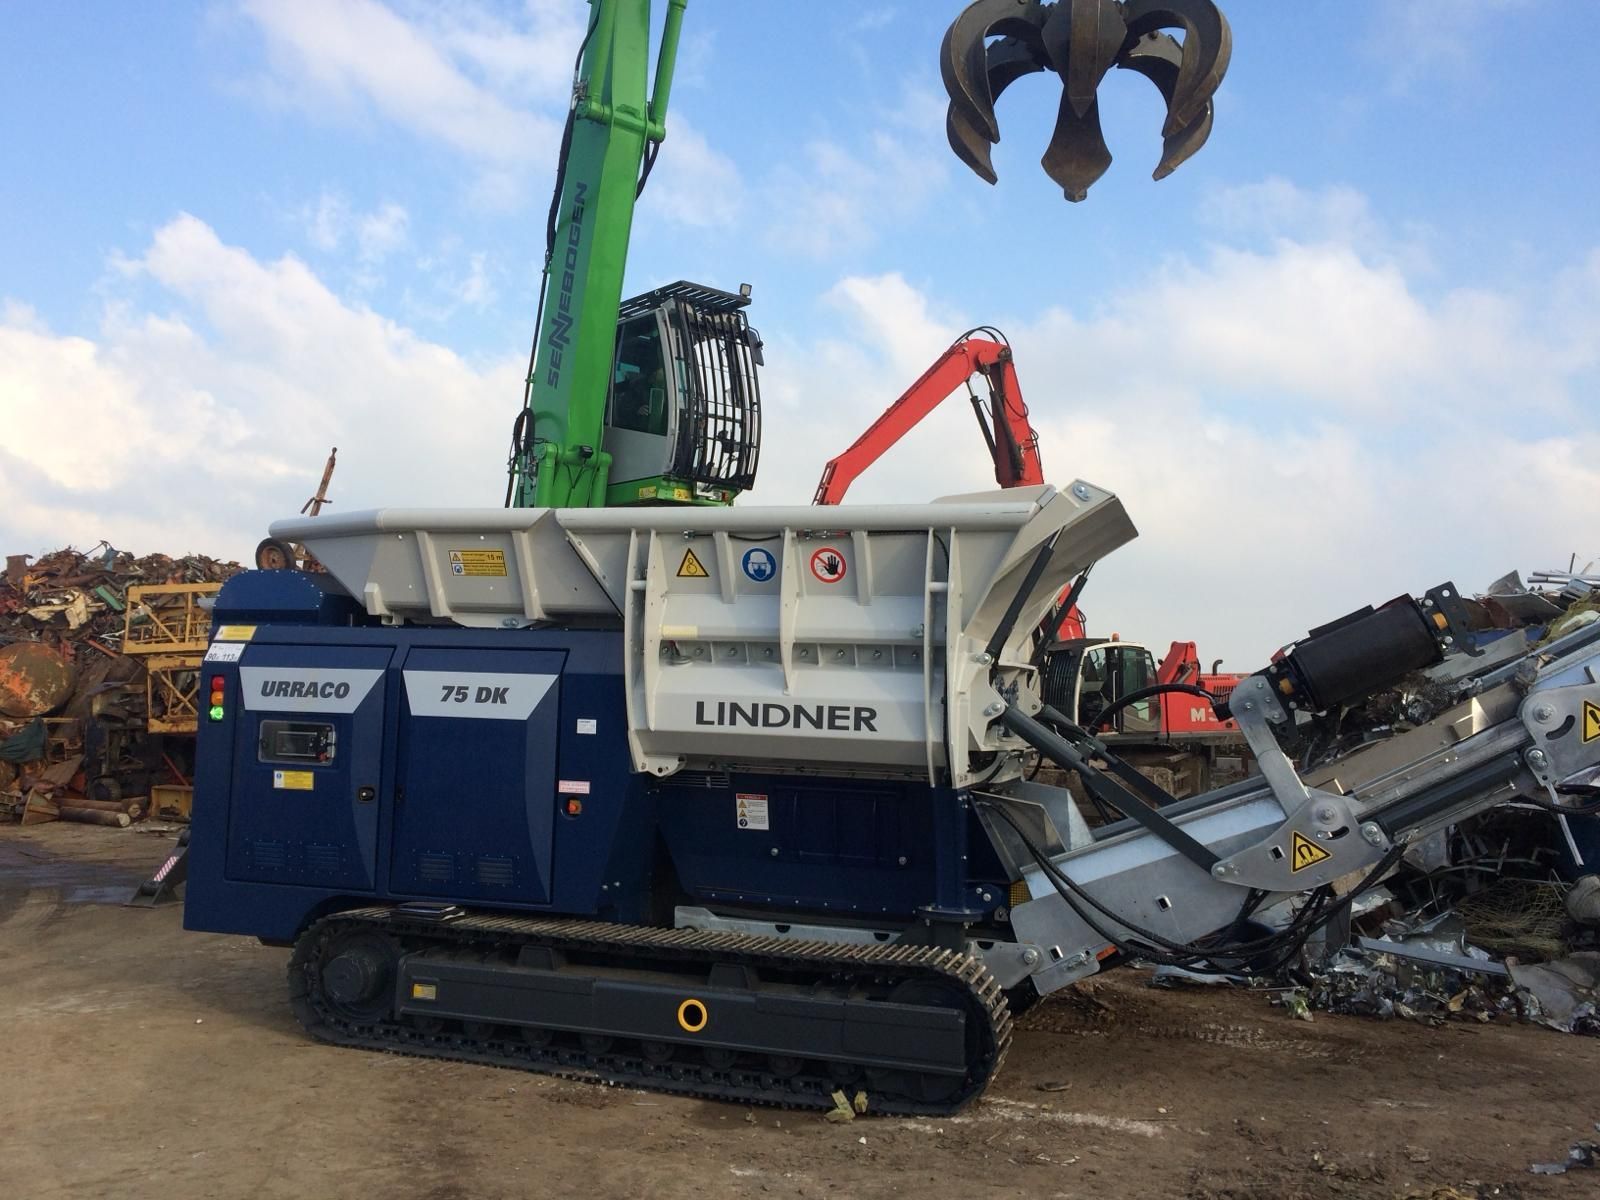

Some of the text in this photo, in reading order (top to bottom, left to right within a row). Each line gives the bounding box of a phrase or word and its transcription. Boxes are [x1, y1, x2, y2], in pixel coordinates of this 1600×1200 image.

[548, 182, 588, 389] SENNEBOGEN
[261, 681, 350, 699] URRACO
[441, 685, 509, 704] 75 DK
[695, 701, 878, 733] LINDNER
